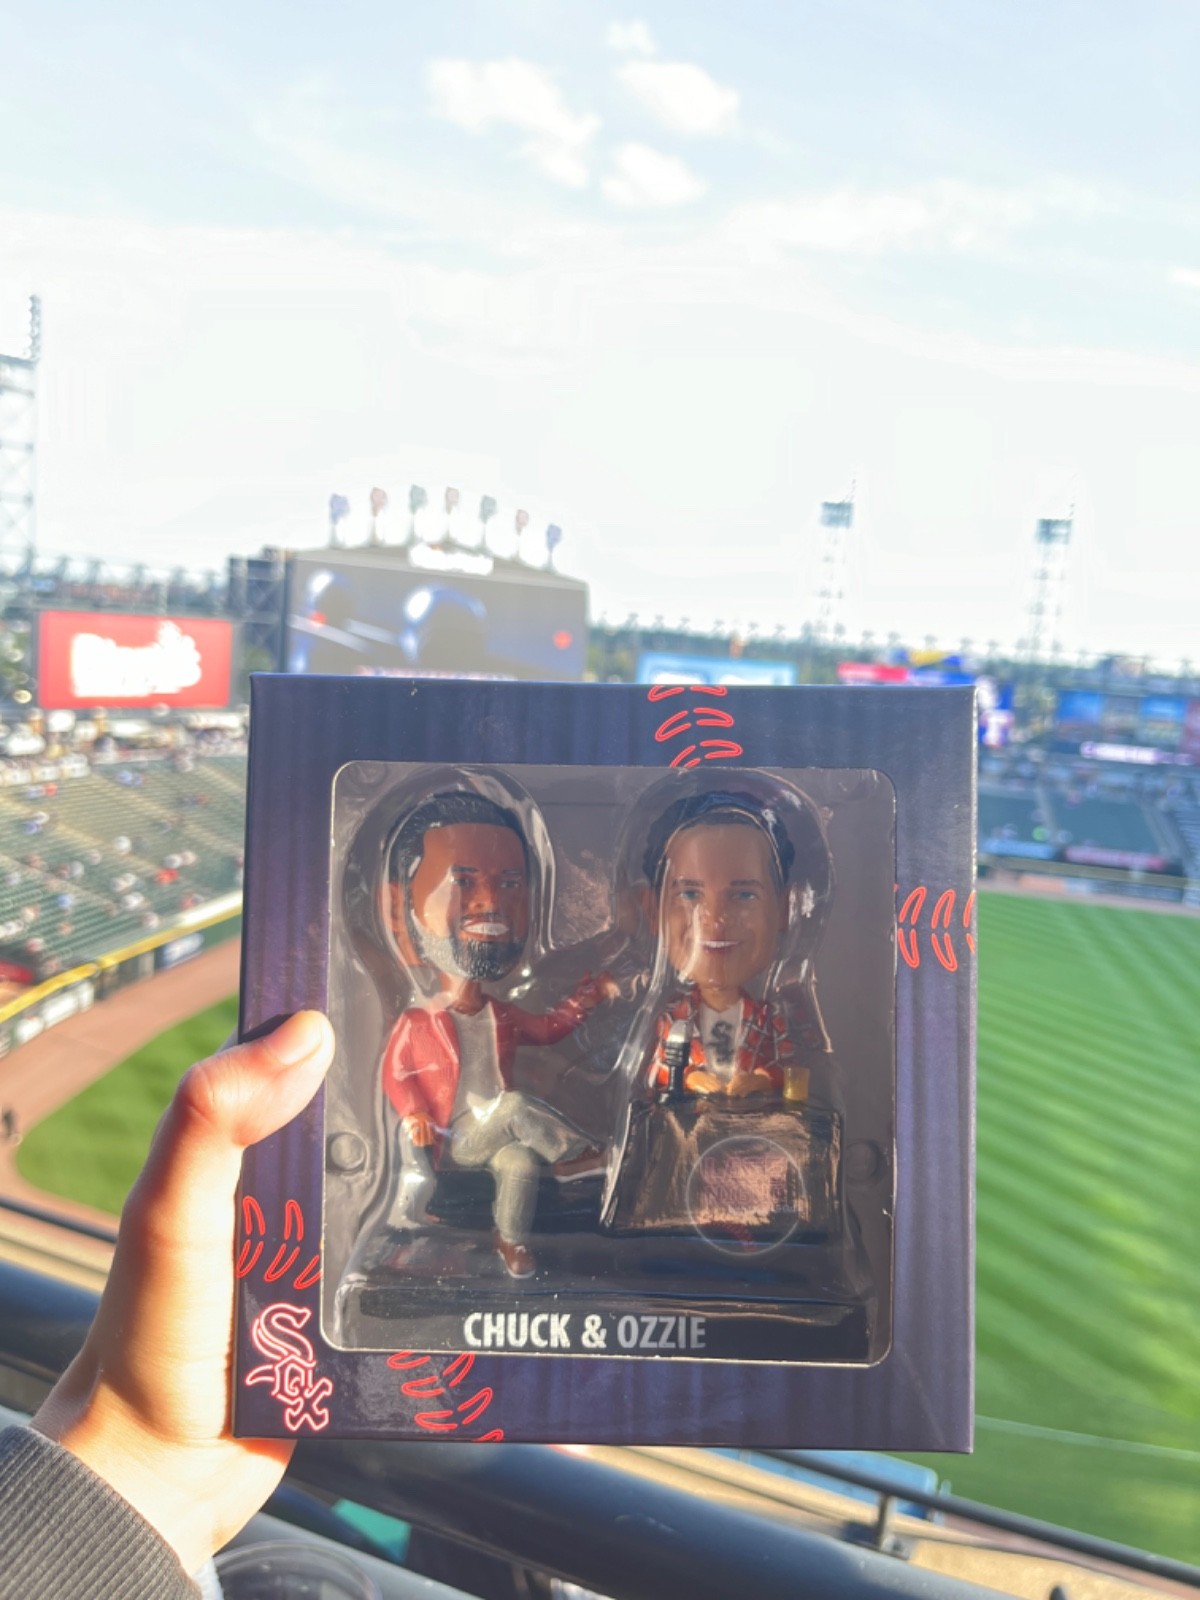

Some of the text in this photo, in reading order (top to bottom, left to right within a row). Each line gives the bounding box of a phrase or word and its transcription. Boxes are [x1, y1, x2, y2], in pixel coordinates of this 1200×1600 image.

[463, 1312, 706, 1349] CHUCK & OZZIE
